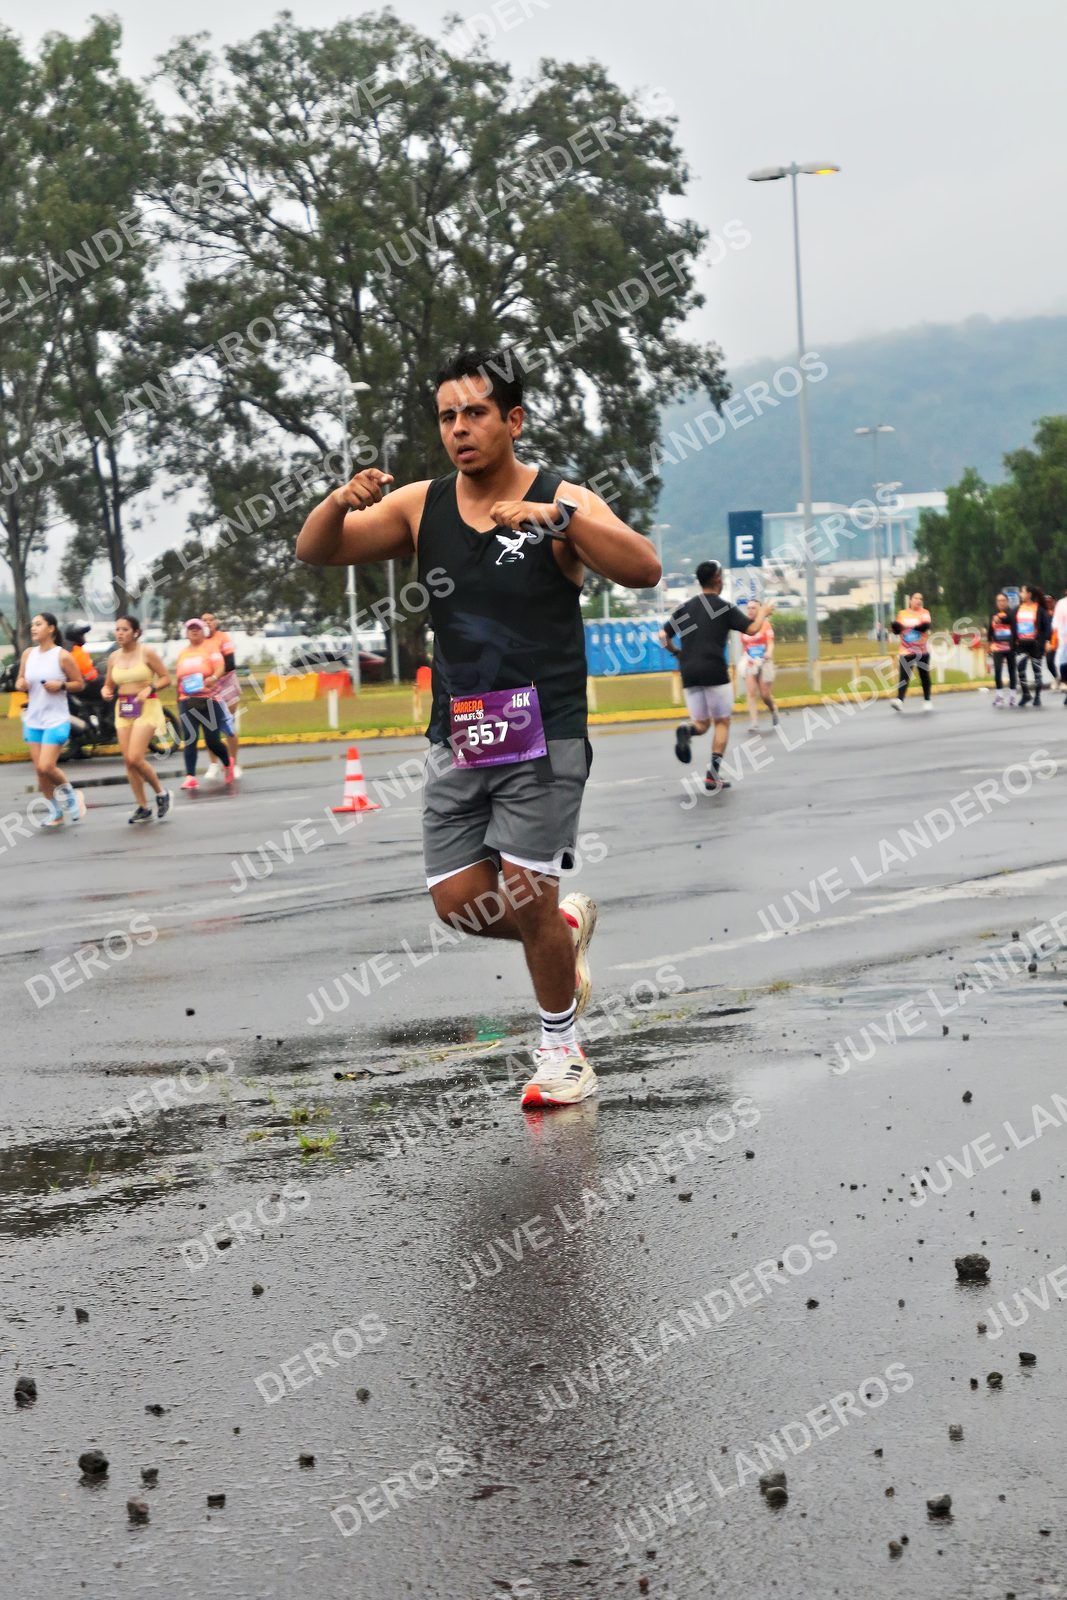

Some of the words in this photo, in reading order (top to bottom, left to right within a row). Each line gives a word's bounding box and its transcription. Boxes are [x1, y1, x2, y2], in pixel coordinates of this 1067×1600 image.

[735, 534, 755, 560] E
[453, 699, 484, 714] CARRERA
[511, 692, 531, 708] 16K
[467, 720, 509, 746] 557
